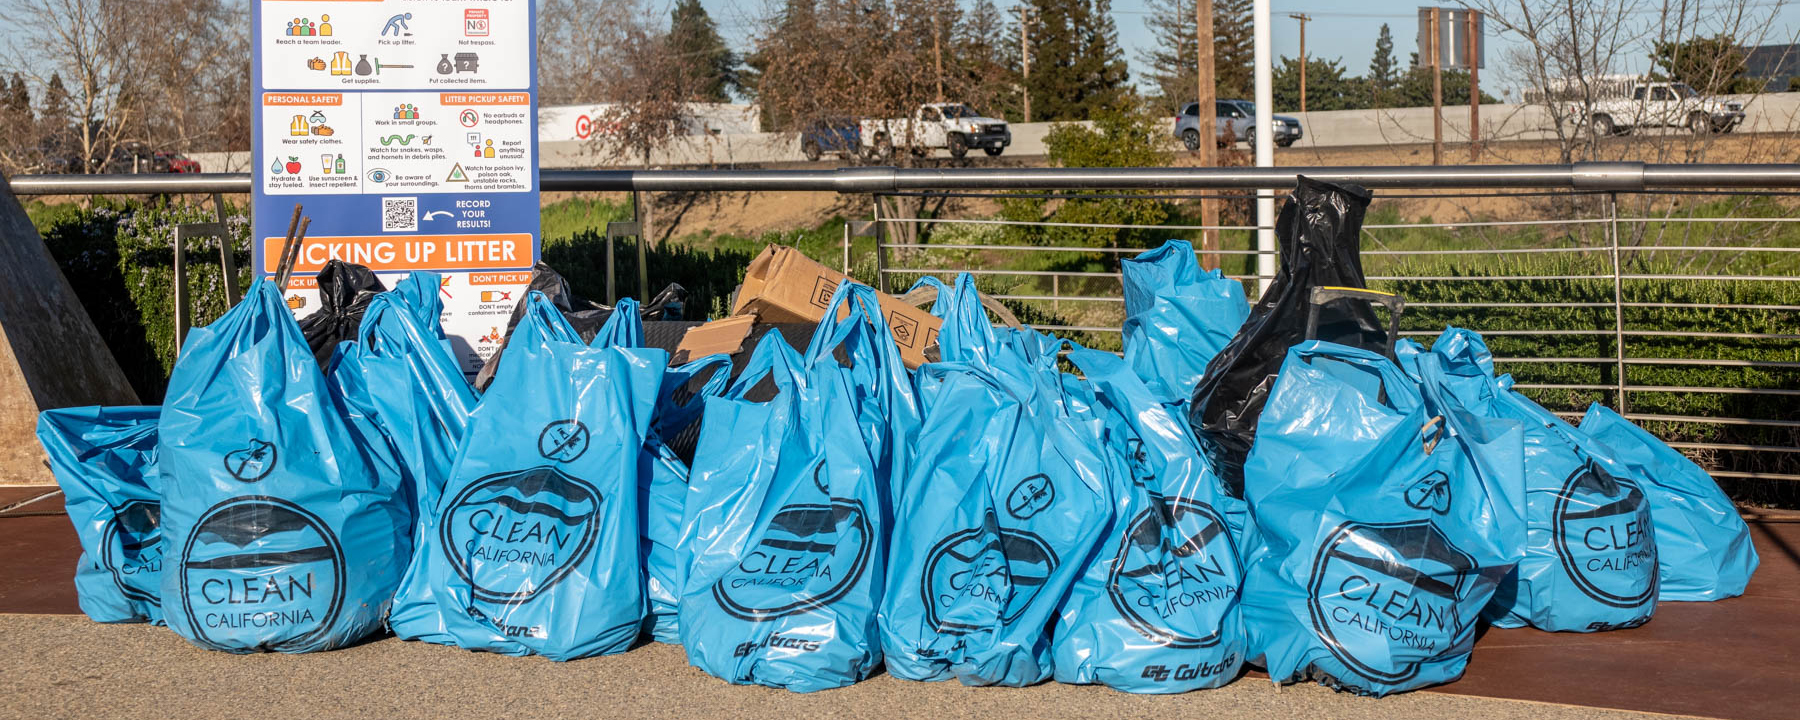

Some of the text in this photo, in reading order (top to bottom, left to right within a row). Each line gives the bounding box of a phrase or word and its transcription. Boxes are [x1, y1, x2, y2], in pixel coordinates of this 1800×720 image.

[456, 200, 490, 208] RECORD
[462, 210, 485, 218] YOUR
[457, 220, 490, 228] RESULTS!
[288, 240, 516, 265] ICKING UP LITTER
[468, 509, 572, 550] CLEAN
[465, 540, 555, 566] CALIFORNIA
[739, 552, 819, 576] CLEA
[202, 572, 313, 604] CLEAN
[1339, 575, 1444, 633] CLEAN
[205, 608, 314, 628] CALIFORNIA
[1332, 606, 1436, 654] CALIFORNIA
[1174, 652, 1236, 681] Caltrans
